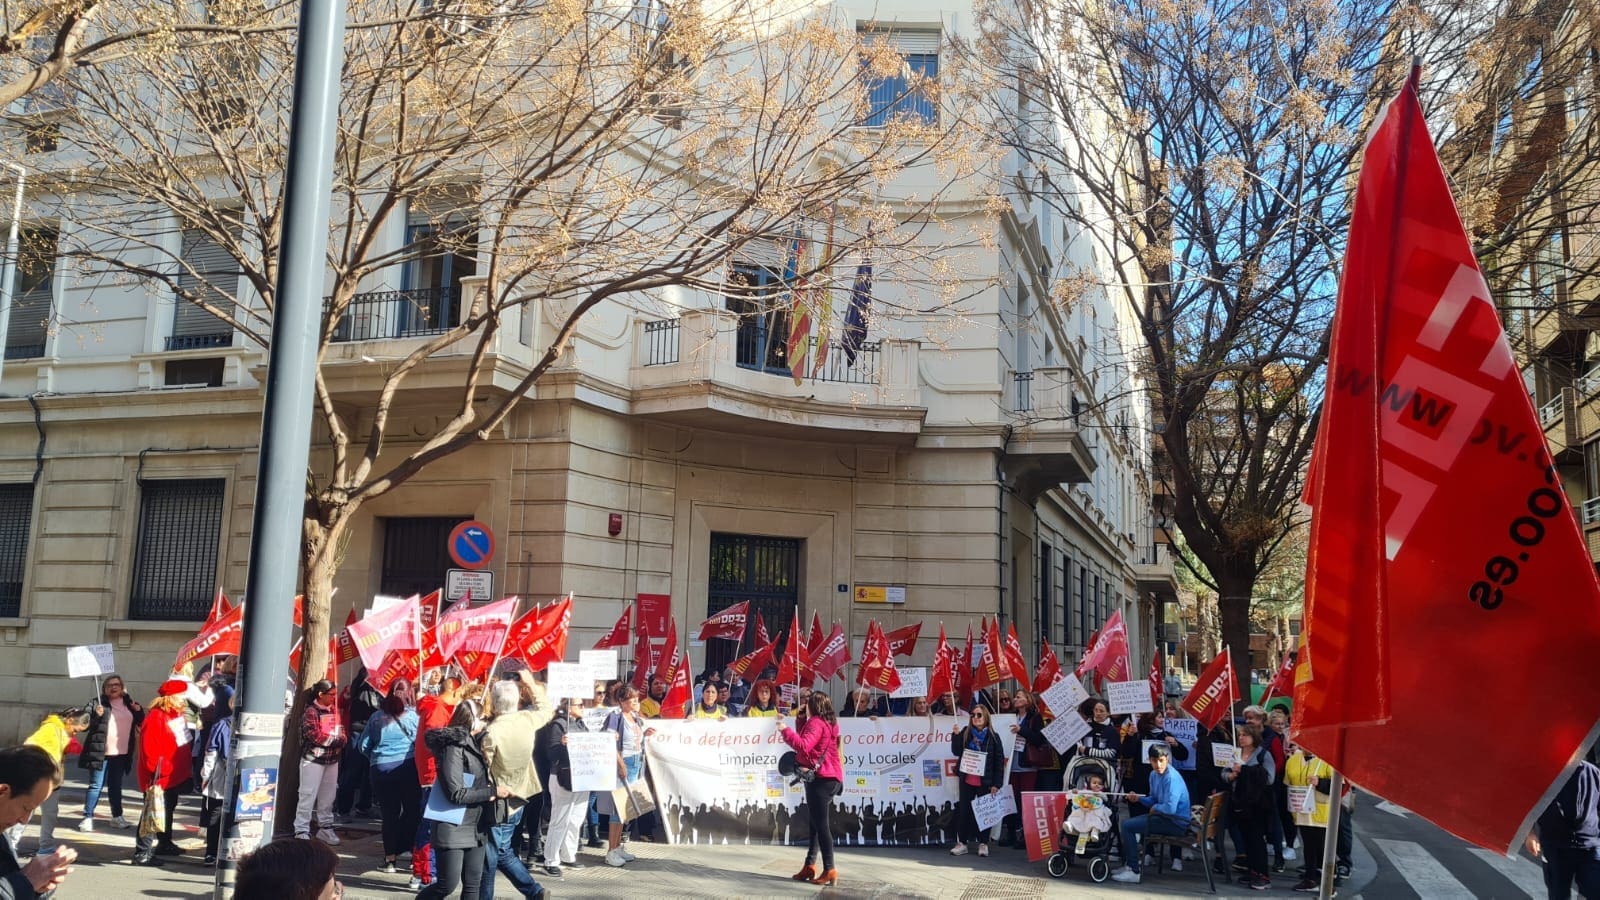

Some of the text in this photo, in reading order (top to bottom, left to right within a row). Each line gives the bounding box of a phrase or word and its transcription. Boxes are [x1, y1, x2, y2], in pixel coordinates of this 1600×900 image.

[1165, 718, 1195, 731] PIRATA
[679, 731, 692, 745] la
[698, 730, 761, 748] defensa
[858, 733, 885, 745] con
[719, 752, 777, 768] Limpieza
[858, 755, 865, 768] y
[869, 751, 917, 765] Locales
[1033, 796, 1049, 839] CCOO
